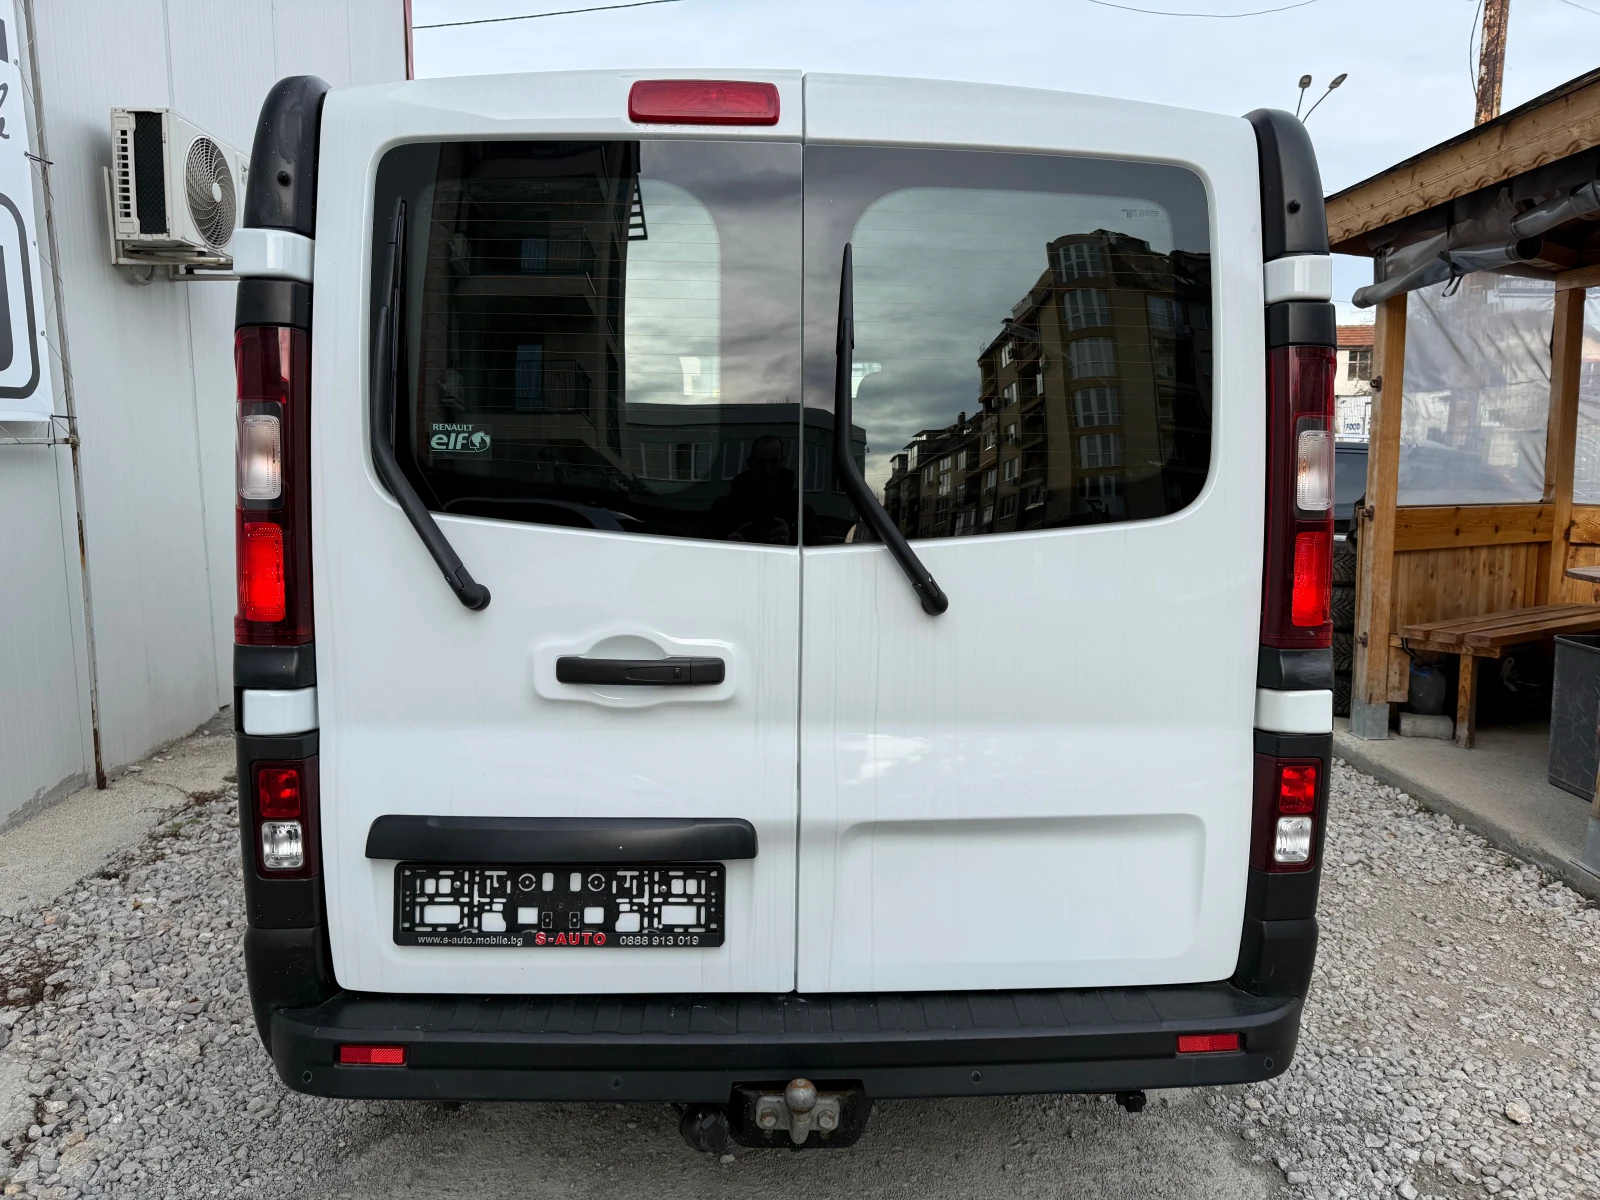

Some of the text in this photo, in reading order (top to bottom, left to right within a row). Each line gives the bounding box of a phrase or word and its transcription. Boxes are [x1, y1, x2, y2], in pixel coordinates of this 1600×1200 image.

[433, 423, 473, 431] RENAULT
[430, 432, 469, 450] elf
[417, 931, 699, 946] www.s-auto.mobile.bg S-AUTO 0888 913 019
